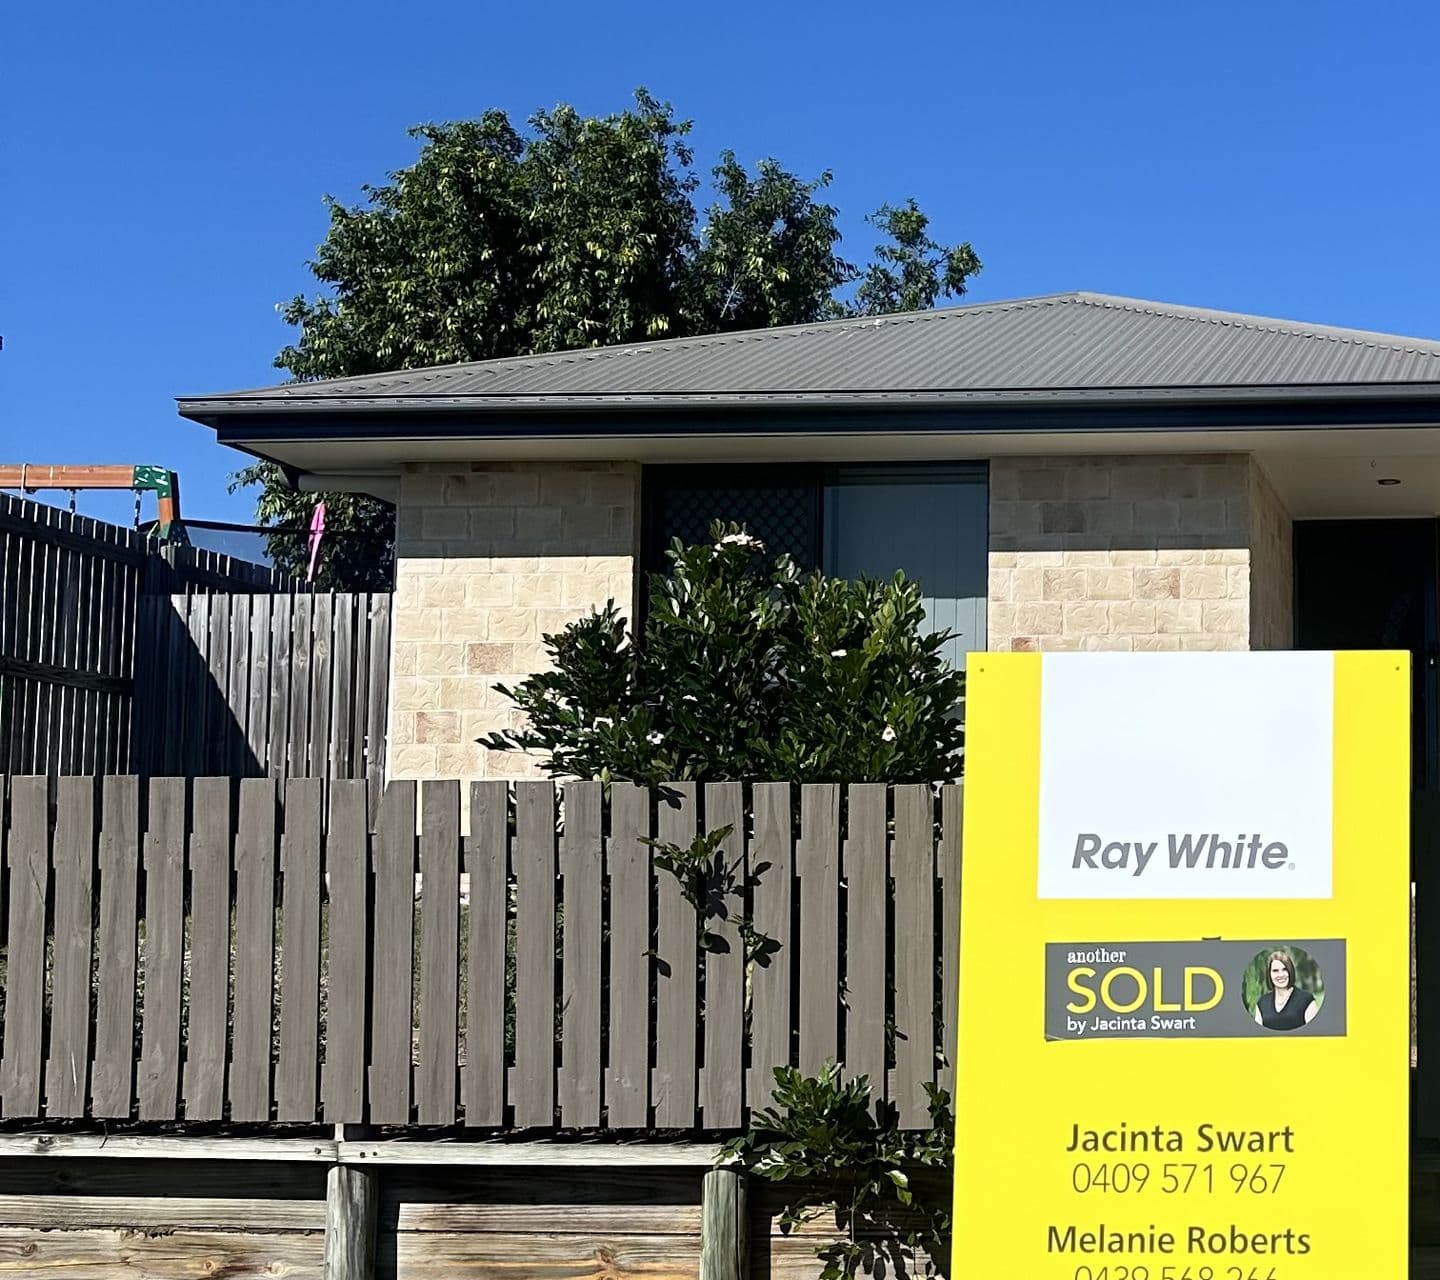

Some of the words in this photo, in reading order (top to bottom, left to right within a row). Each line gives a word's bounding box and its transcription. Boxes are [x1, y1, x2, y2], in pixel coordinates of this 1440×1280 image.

[1071, 832, 1158, 877] Ray
[1067, 948, 1127, 964] another
[1066, 966, 1225, 1014] SOLD
[1067, 1015, 1087, 1035] by
[1090, 1016, 1147, 1031] Jacinta
[1150, 1015, 1196, 1030] Swart
[1066, 1121, 1184, 1153] Jacinta
[1196, 1123, 1295, 1154] Swart
[1072, 1162, 1151, 1194] 0409
[1161, 1163, 1214, 1194] 571
[1229, 1163, 1286, 1195] 967
[1047, 1223, 1176, 1254] Melanie
[1187, 1223, 1311, 1255] Roberts
